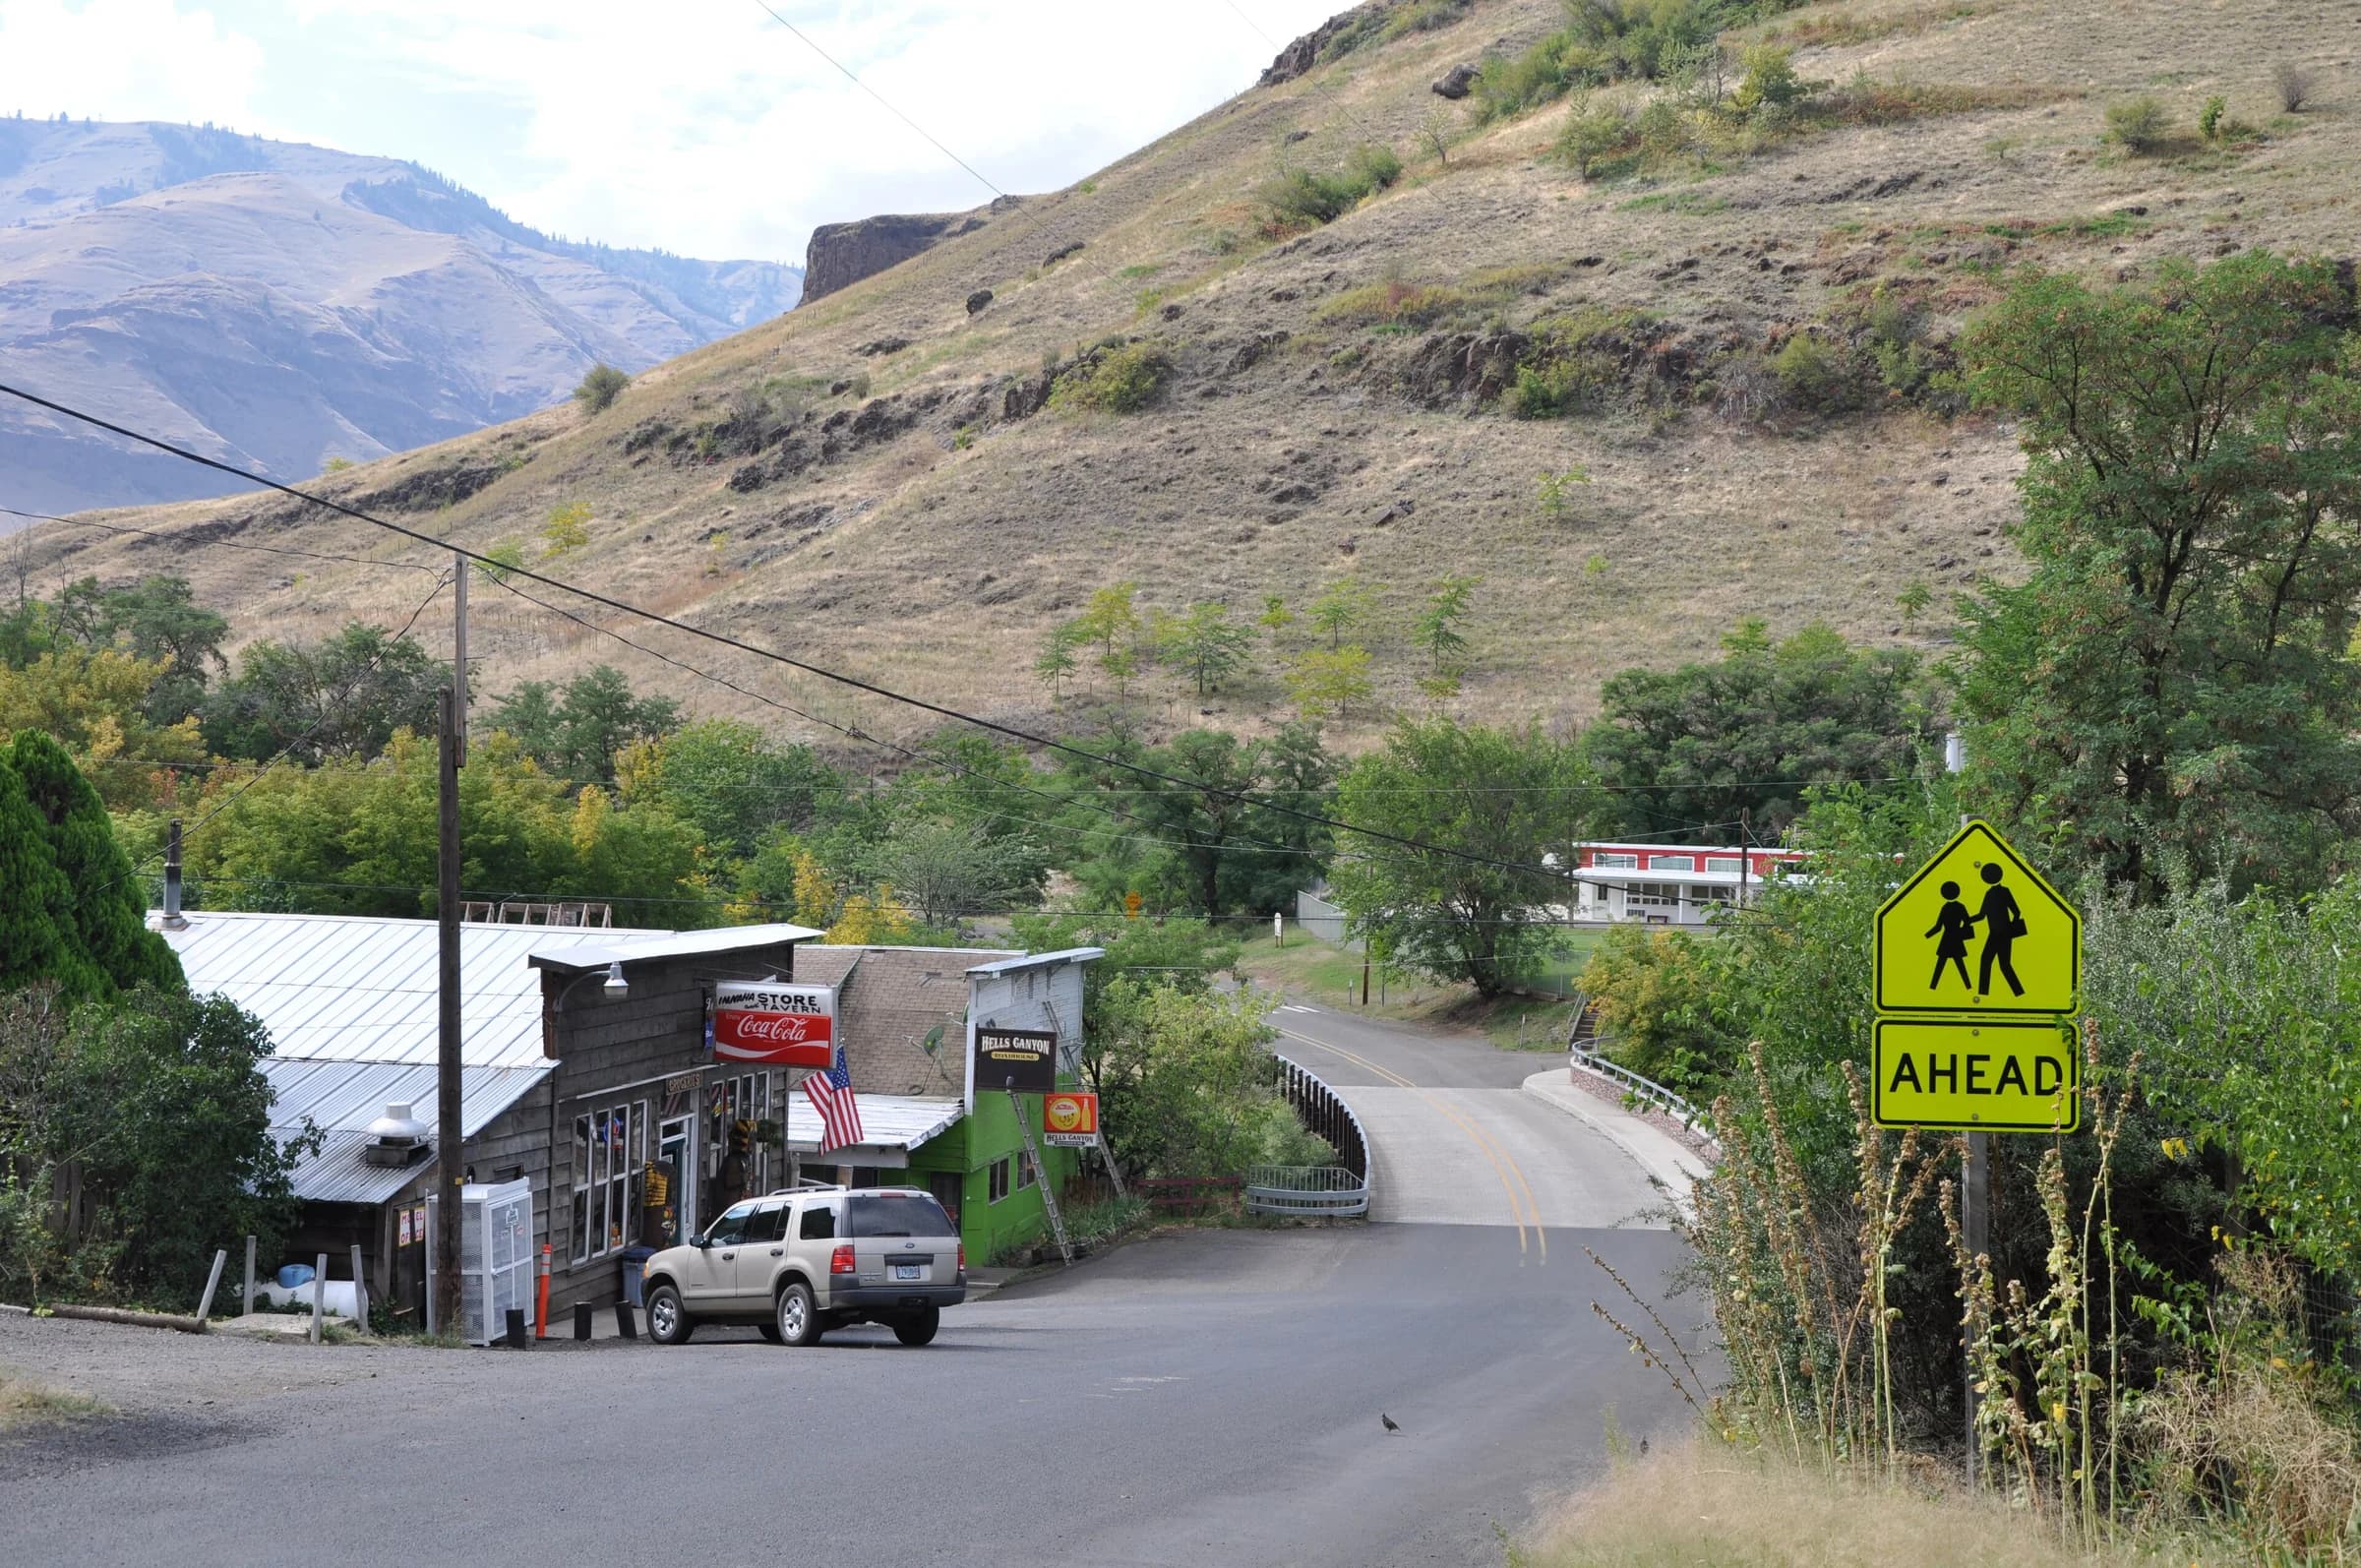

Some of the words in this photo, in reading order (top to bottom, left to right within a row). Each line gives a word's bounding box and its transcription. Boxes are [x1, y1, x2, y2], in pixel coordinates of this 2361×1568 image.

[718, 993, 756, 1004] IMNAHA
[757, 993, 817, 1006] STORE
[762, 1003, 821, 1014] TAVERN
[737, 1015, 810, 1041] Coca-Cola
[982, 1036, 1011, 1053] HELLS
[1012, 1037, 1051, 1055] CANYON
[1889, 1053, 2063, 1096] AHEAD
[1047, 1133, 1066, 1142] HELLS
